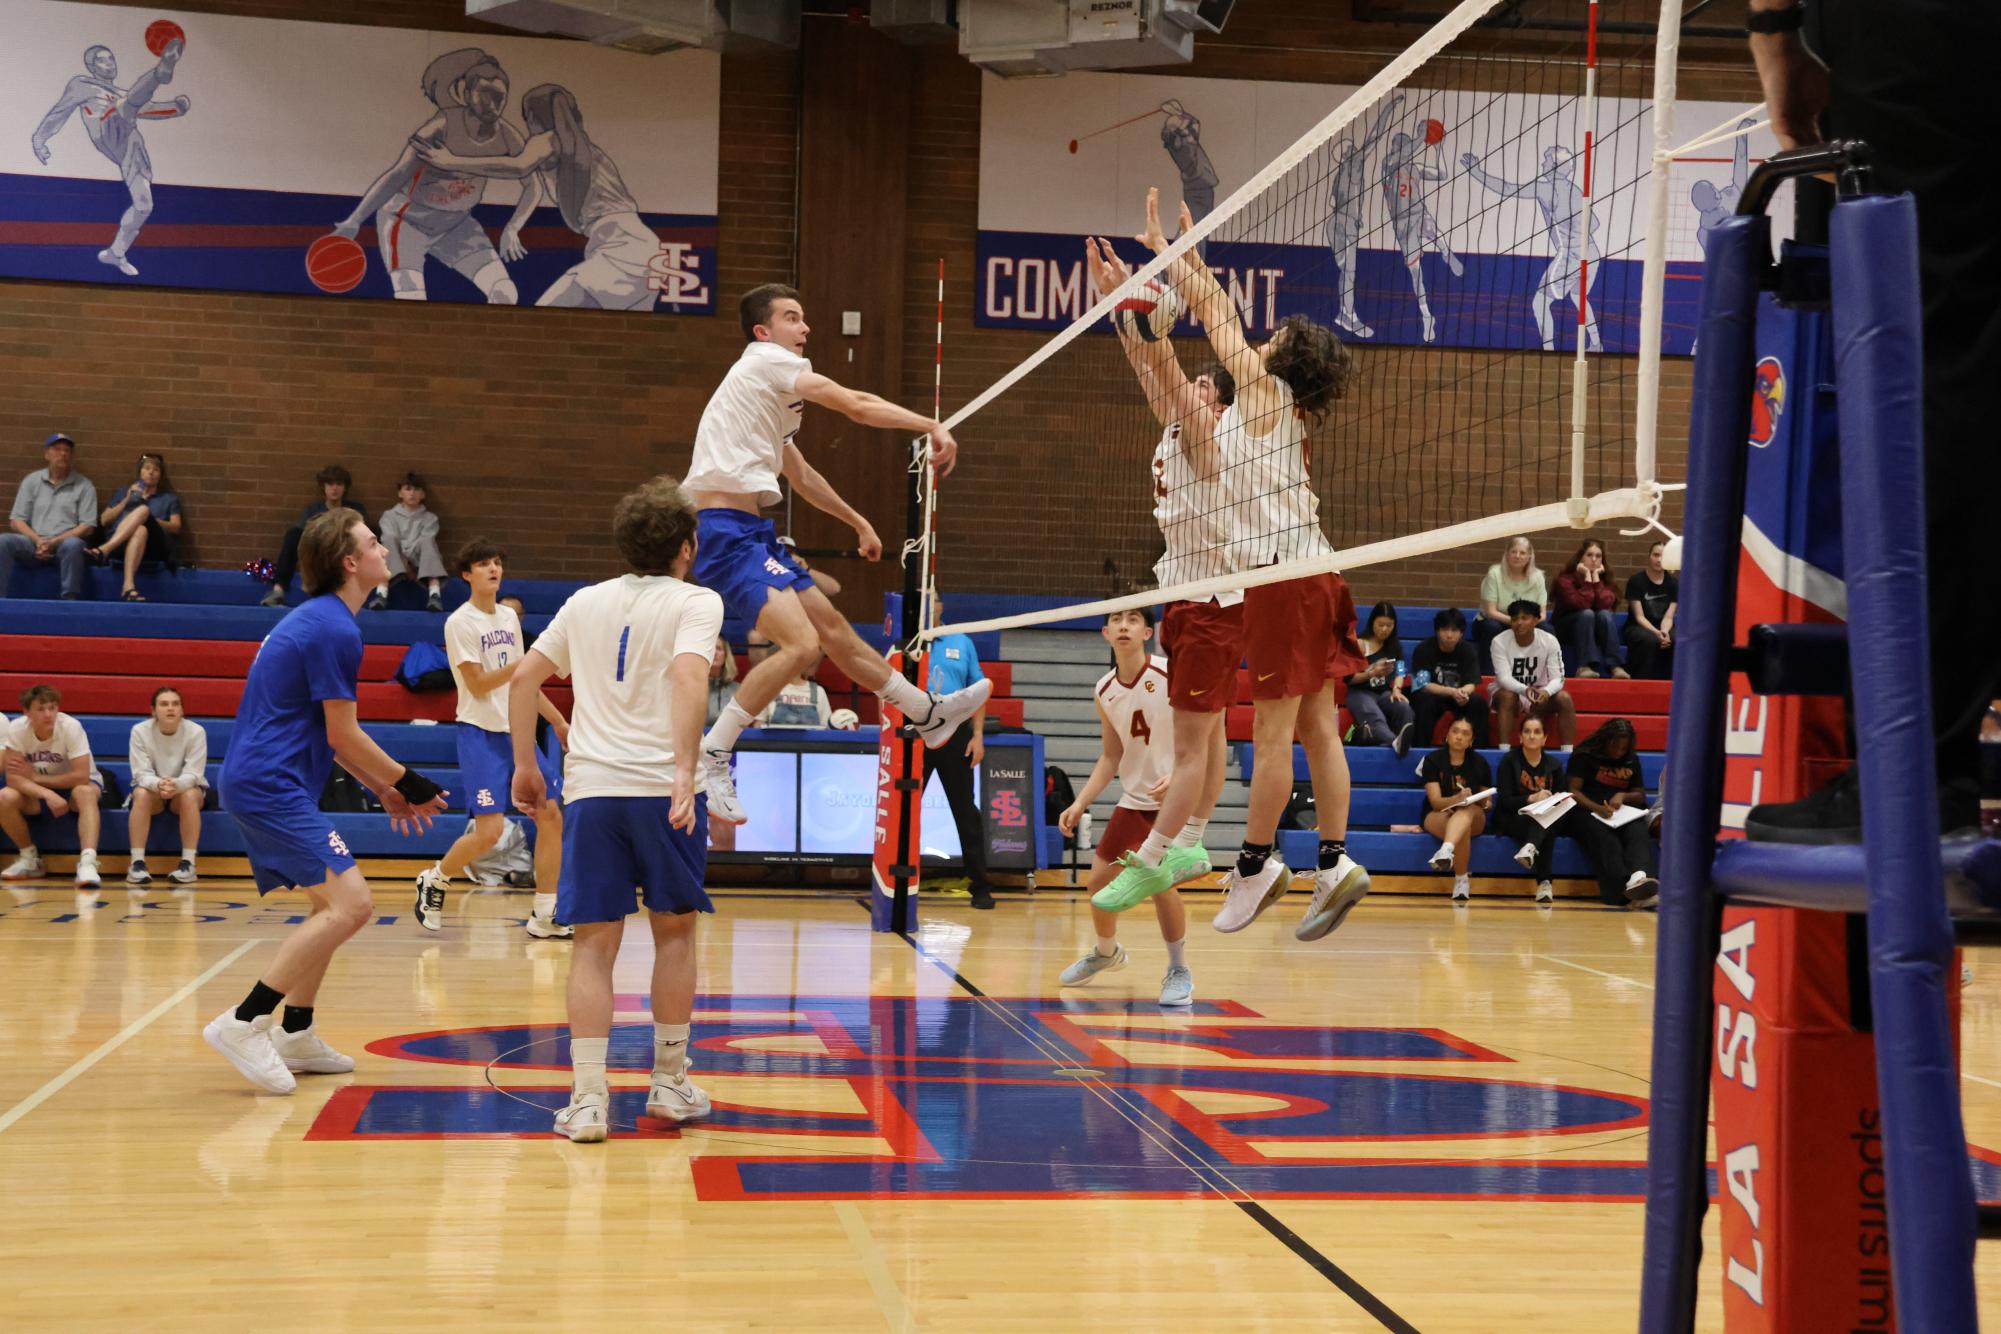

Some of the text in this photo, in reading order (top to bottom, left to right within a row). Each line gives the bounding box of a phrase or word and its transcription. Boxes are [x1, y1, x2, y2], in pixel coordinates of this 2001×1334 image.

[616, 625, 630, 682] 1
[1511, 656, 1538, 677] BY
[1130, 709, 1151, 747] 4
[874, 745, 892, 845] SALLE
[1716, 690, 1770, 1306] LA SALE
